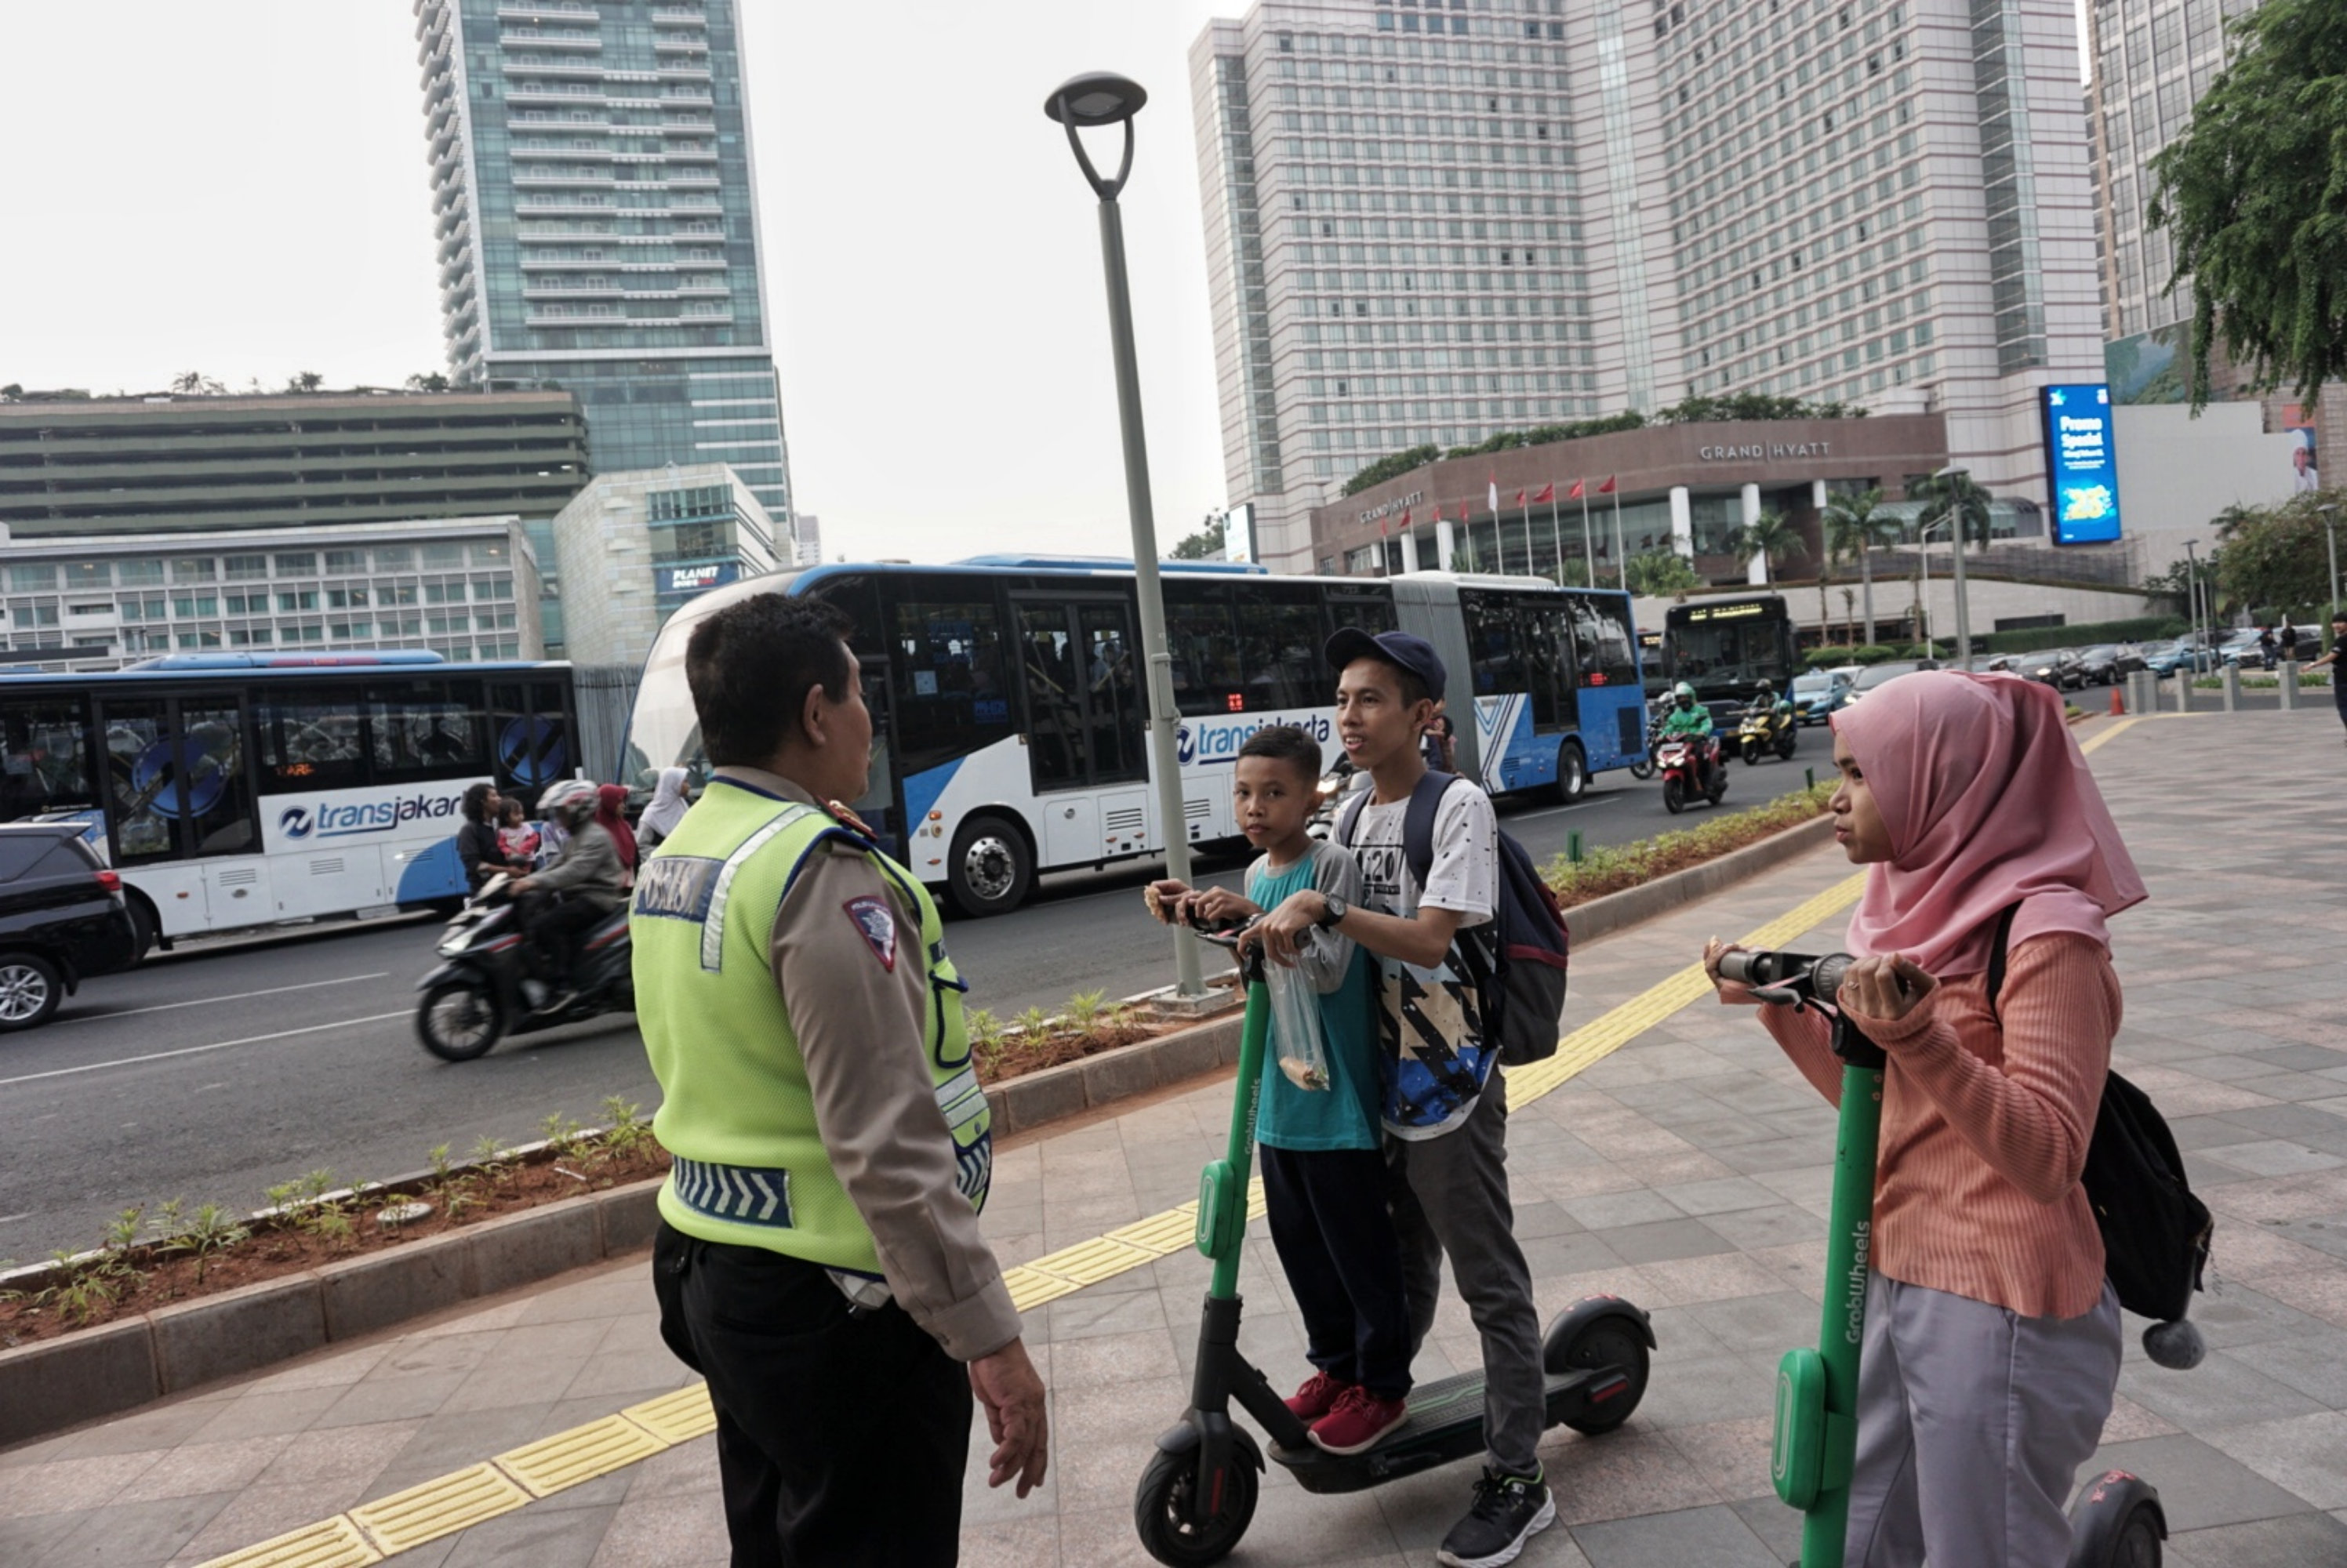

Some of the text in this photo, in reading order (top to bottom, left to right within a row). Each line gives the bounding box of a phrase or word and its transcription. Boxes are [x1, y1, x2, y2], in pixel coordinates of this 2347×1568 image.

[1700, 442, 1829, 460] GRAND HYATT
[673, 565, 719, 581] PLANET
[317, 793, 469, 836] transjakar
[1845, 1220, 1871, 1345] GrabWheels
